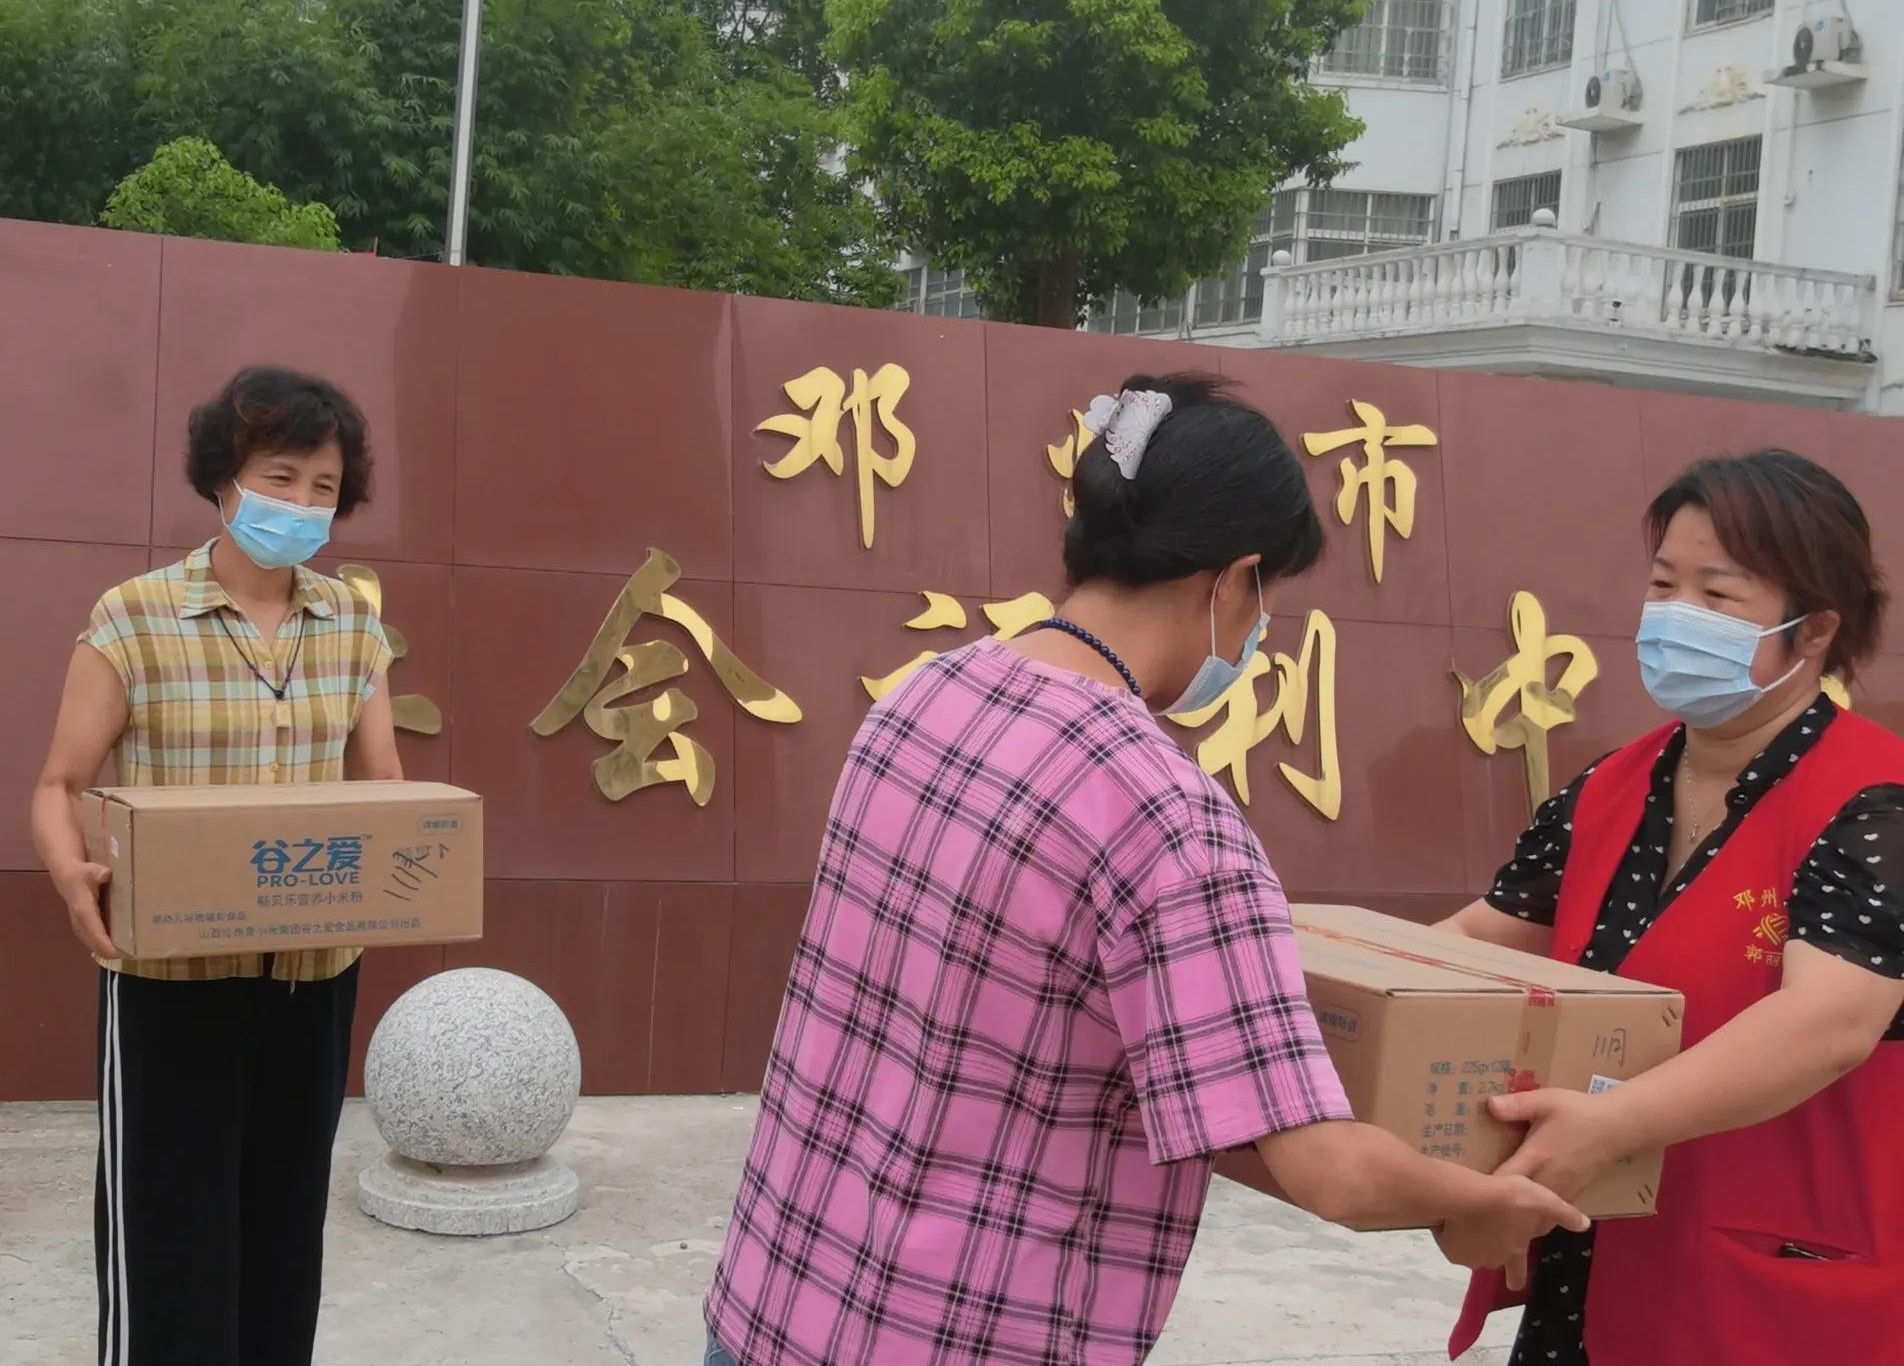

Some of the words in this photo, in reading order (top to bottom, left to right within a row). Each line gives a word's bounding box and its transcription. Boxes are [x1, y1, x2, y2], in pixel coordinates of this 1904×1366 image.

[752, 363, 1437, 585] 邓市
[338, 547, 1852, 822] 会利中
[250, 836, 362, 874] 谷之爱
[257, 872, 360, 888] PRO-LOVE
